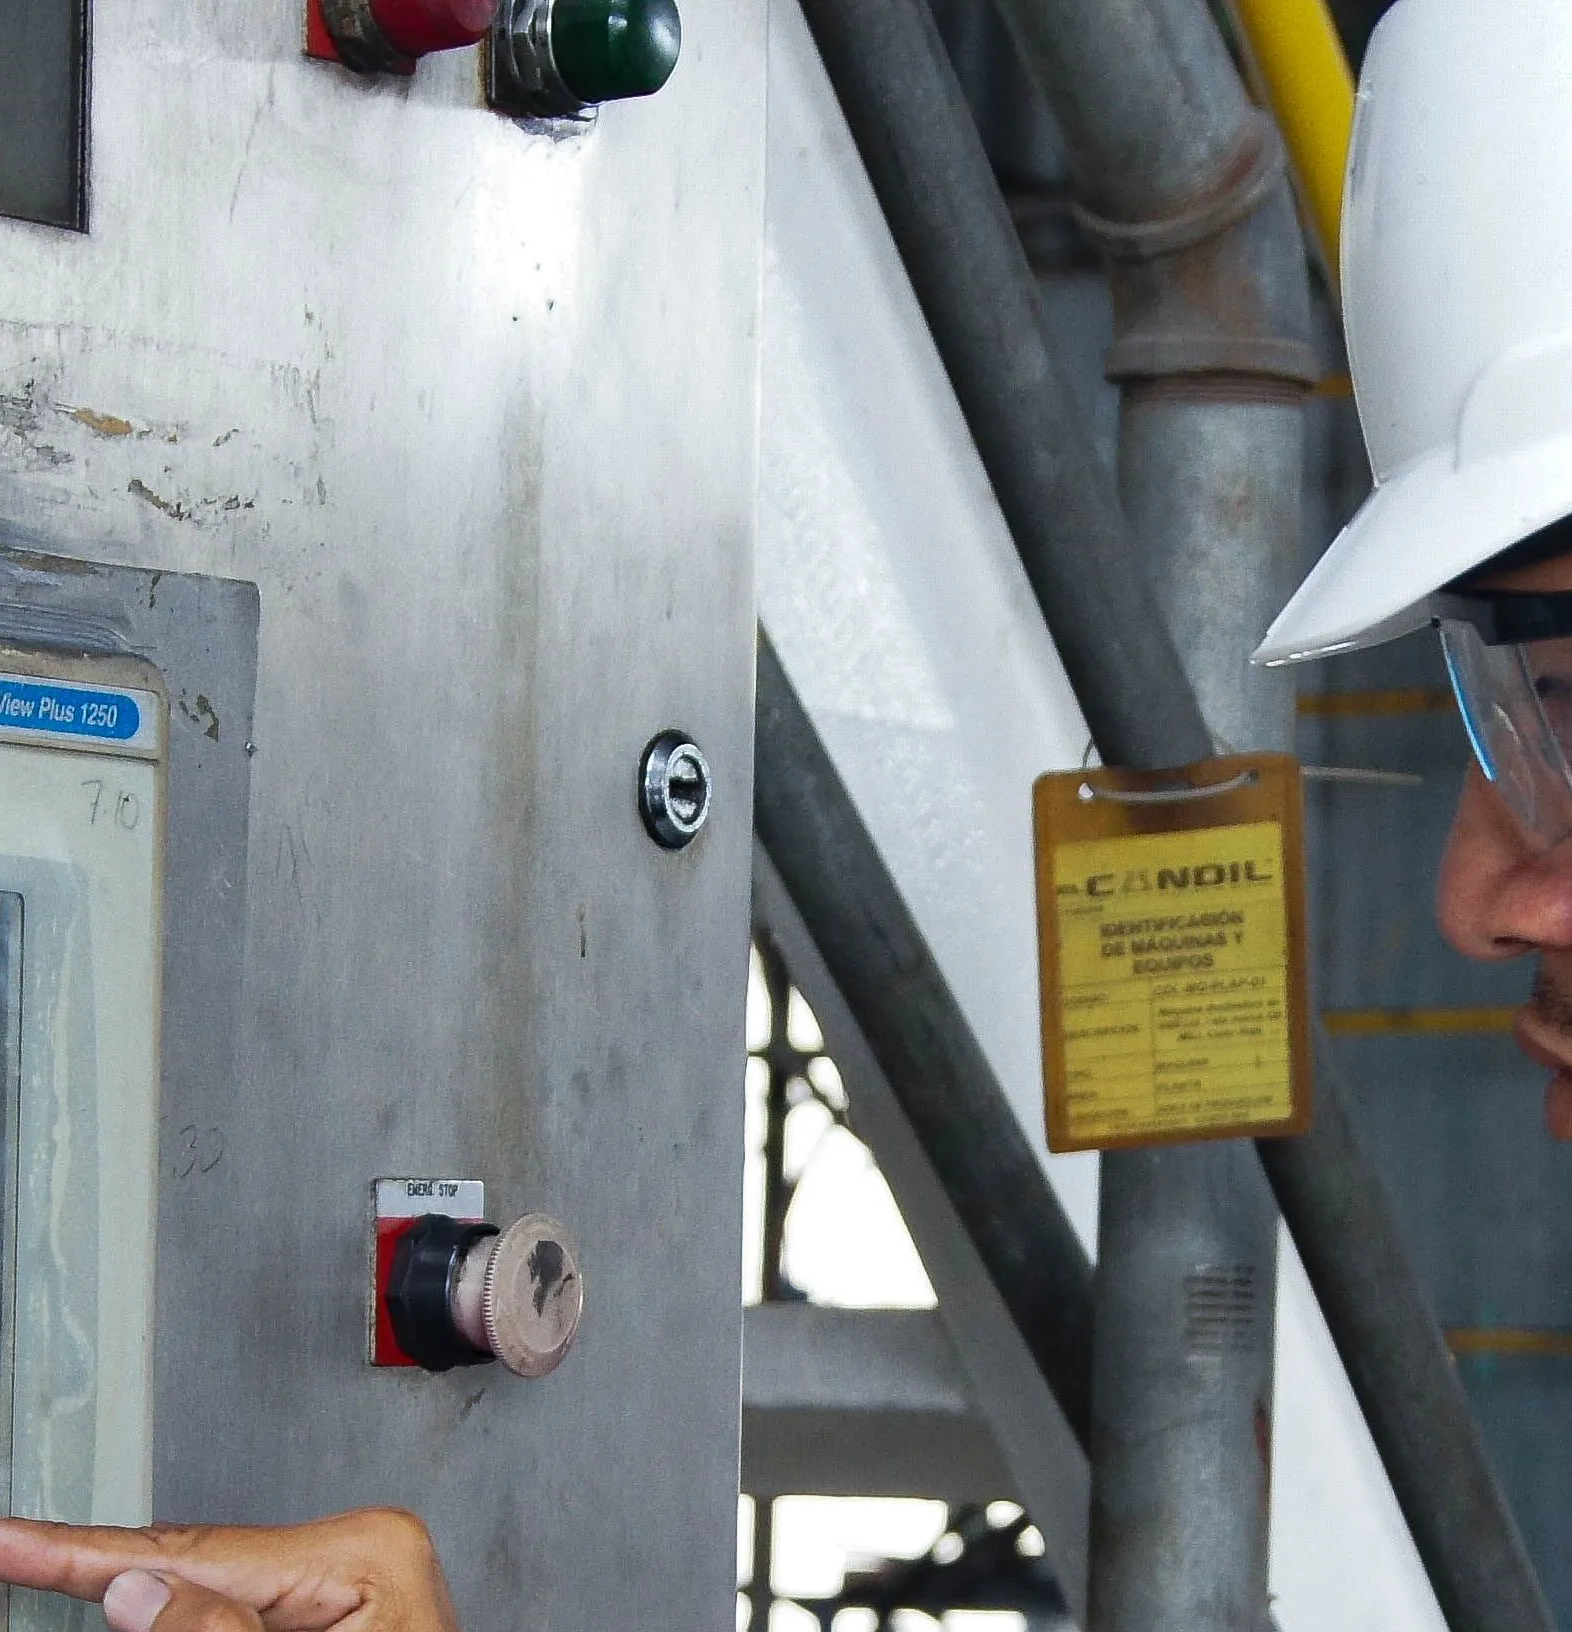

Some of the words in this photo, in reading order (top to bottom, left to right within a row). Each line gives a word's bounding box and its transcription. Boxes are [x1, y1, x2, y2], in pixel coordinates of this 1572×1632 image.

[38, 696, 75, 724] Plus
[80, 702, 118, 728] 1250
[439, 1183, 459, 1197] STOP
